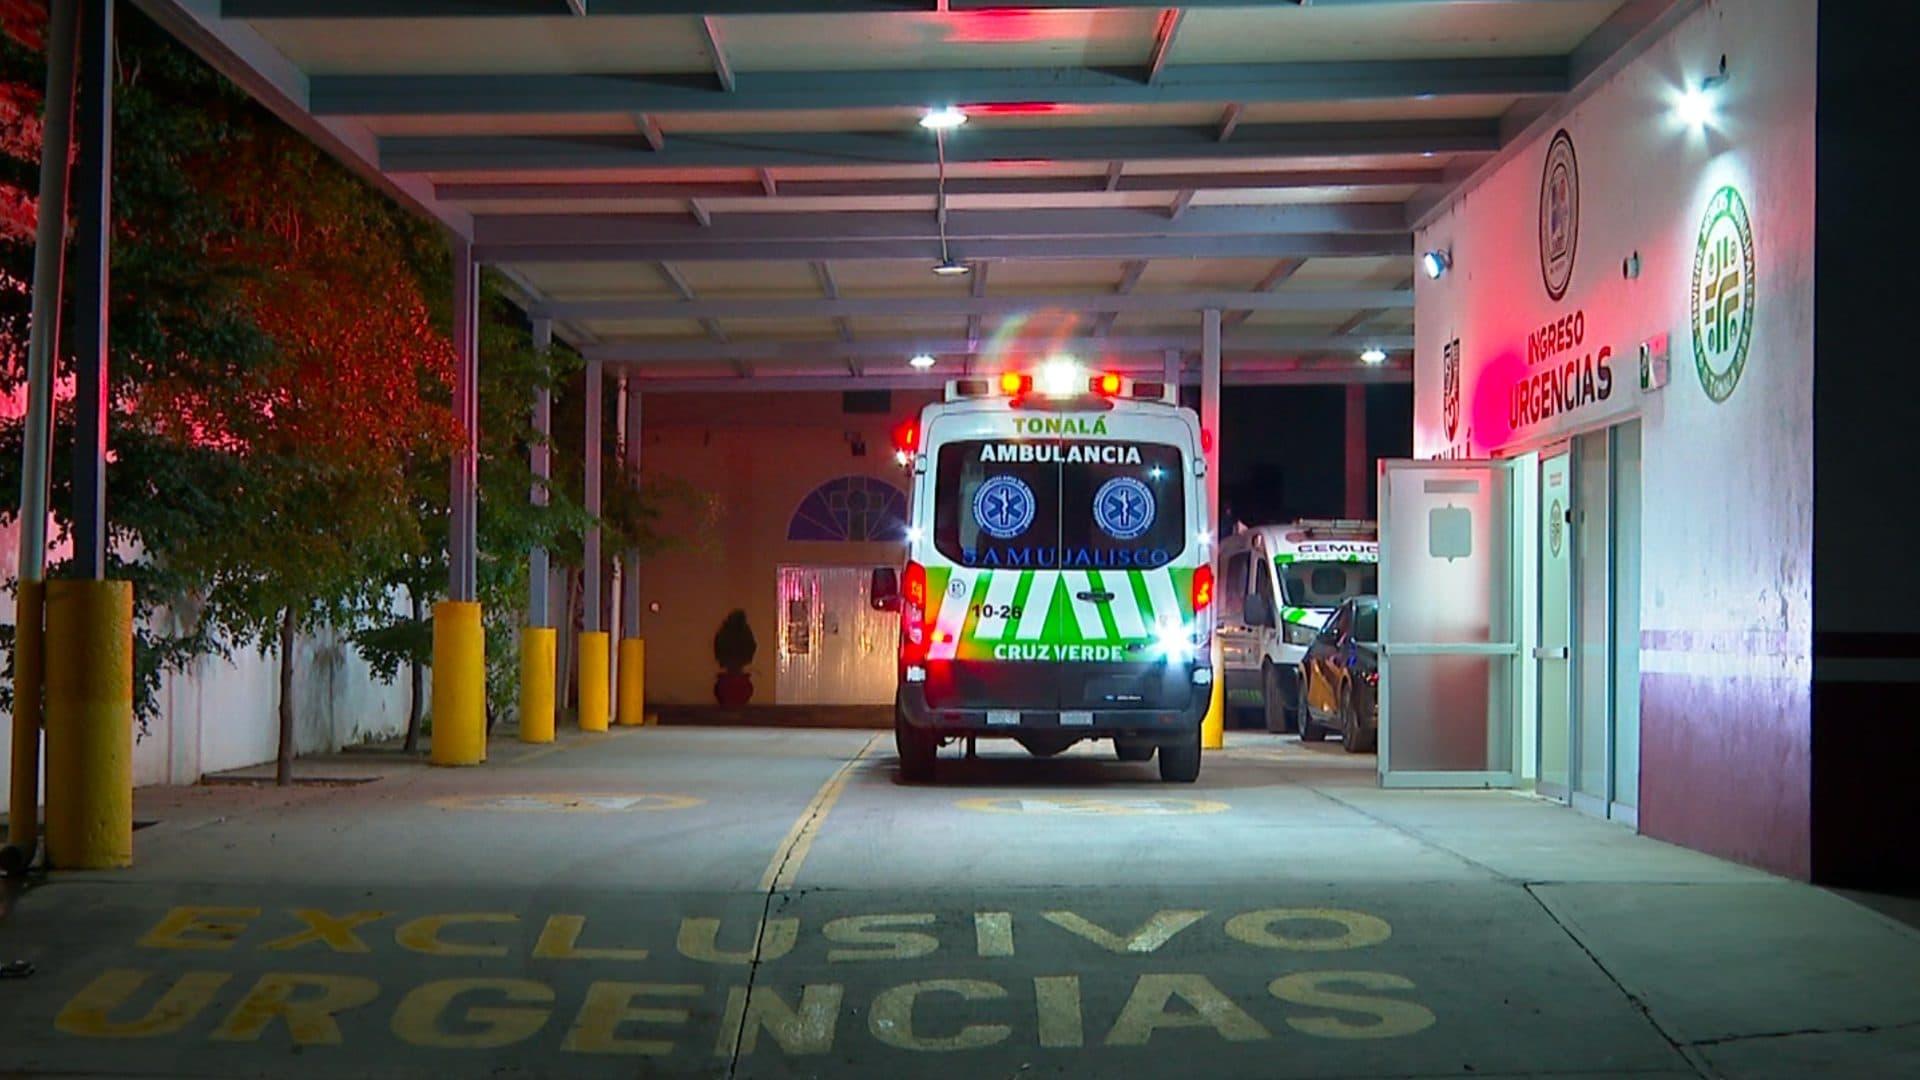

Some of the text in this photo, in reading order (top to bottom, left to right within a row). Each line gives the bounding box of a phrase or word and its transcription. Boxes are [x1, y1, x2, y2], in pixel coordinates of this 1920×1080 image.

[1528, 310, 1584, 365] INGRESO
[1509, 345, 1612, 430] URGENCIAS
[1012, 414, 1107, 434] TONALÁ
[980, 443, 1141, 464] AMBULANCIA
[962, 547, 1169, 566] SAMU JALISCO
[972, 604, 1022, 619] 10-26
[993, 644, 1123, 661] CRUZ VERDE
[136, 904, 1393, 964] EXCLUSIVO
[53, 969, 1436, 1057] URGENCIAS
